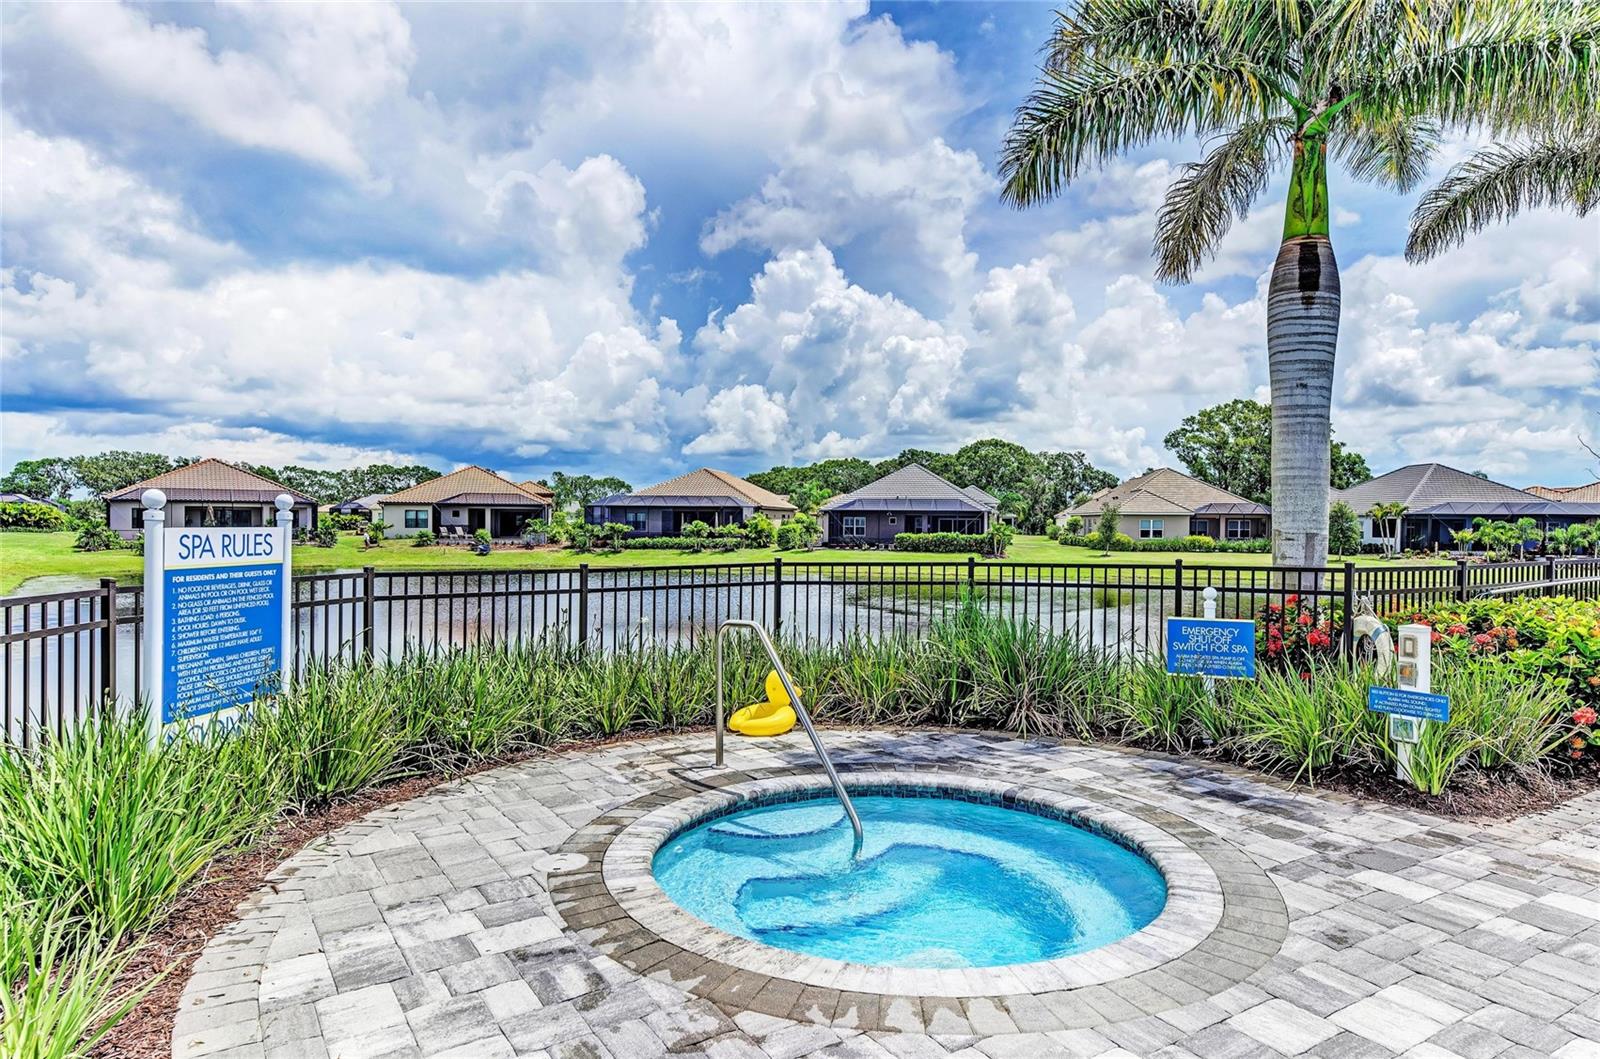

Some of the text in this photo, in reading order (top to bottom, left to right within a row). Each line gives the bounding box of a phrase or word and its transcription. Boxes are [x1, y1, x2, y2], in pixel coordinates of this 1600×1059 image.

[178, 533, 273, 560] SPA RULES
[186, 574, 215, 582] RESIDENTS
[216, 572, 228, 580] AND
[188, 600, 203, 608] GLASS
[212, 598, 232, 606] ANIMALS
[178, 616, 200, 624] BATHING
[178, 631, 200, 640] SHOWER
[200, 628, 217, 637] BEFORE
[1182, 626, 1240, 637] EMERGENCY
[178, 638, 202, 648] MAXIMUM
[203, 636, 219, 644] WATER
[220, 630, 248, 641] TEMPERATURE
[1188, 634, 1232, 644] SHUT-OFF
[177, 646, 201, 656] CHILDREN
[202, 643, 218, 651] UNDER
[1173, 642, 1248, 654] SWITCH FOR SPA
[177, 660, 204, 670] PREGNANT
[177, 670, 191, 678] WITH
[192, 666, 209, 674] HEALTH
[209, 662, 233, 671] PROBLEMS
[243, 656, 258, 664] PEOPLE
[237, 664, 251, 672] OTHER
[177, 684, 194, 692] CAUSE
[226, 674, 244, 682] SHOULD
[228, 676, 256, 688] CONSULTING
[197, 699, 220, 710] SWALLOW
